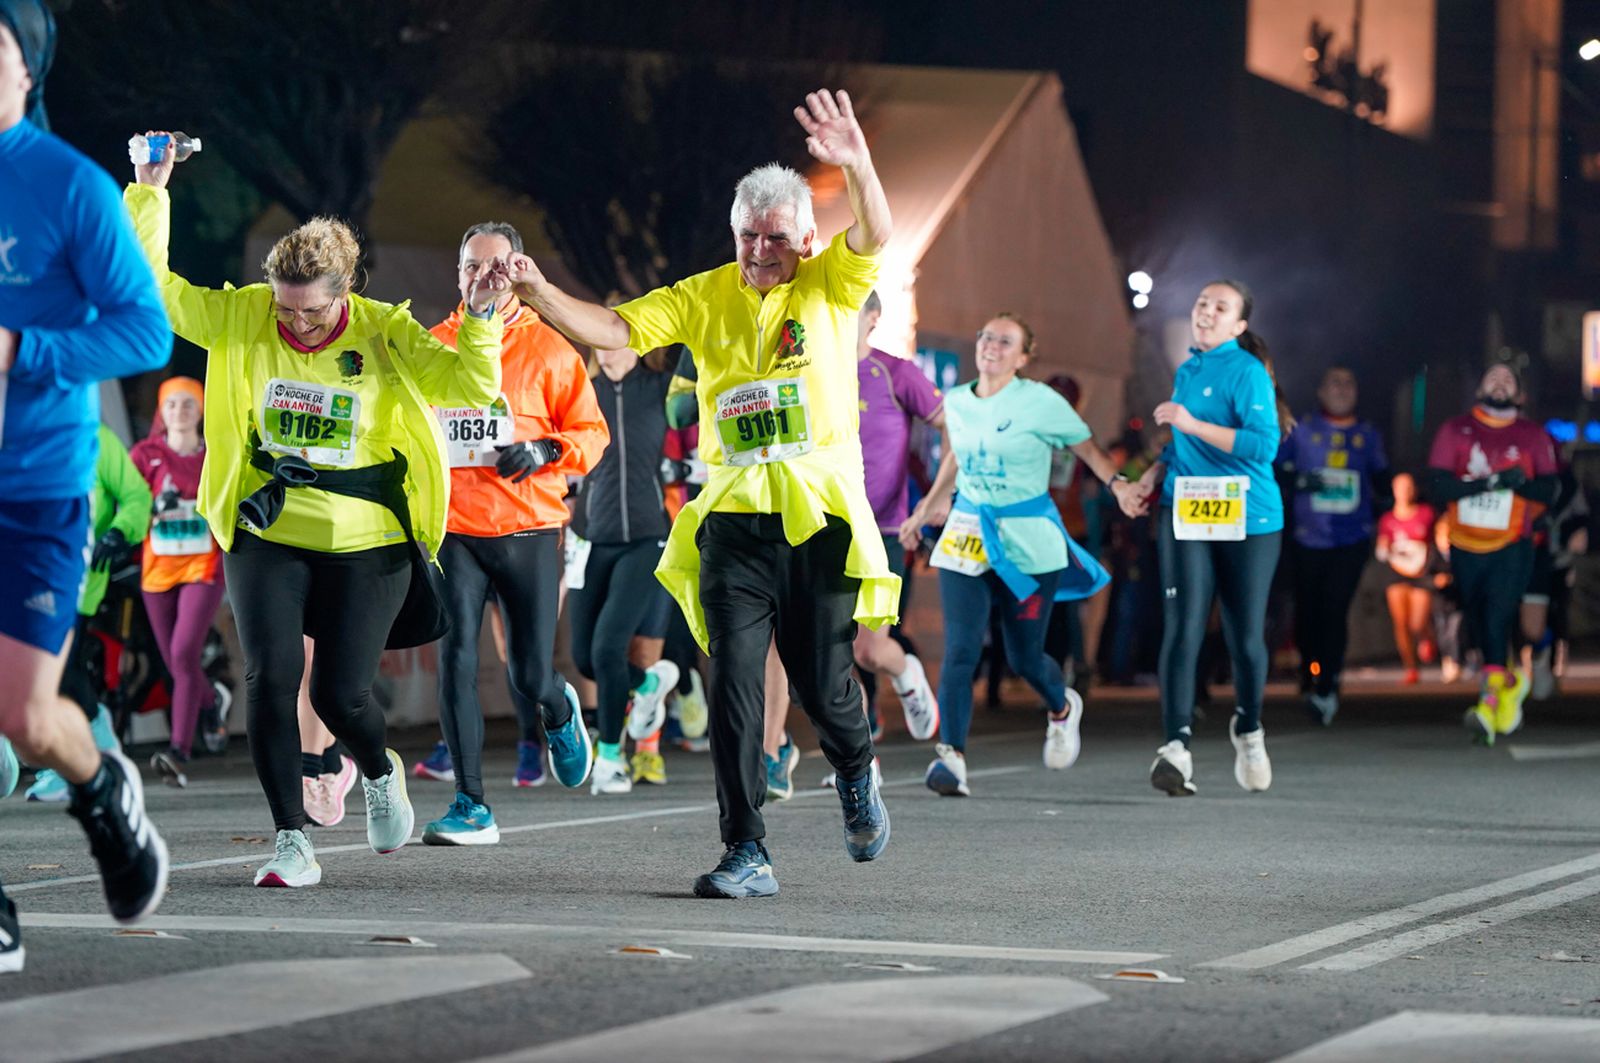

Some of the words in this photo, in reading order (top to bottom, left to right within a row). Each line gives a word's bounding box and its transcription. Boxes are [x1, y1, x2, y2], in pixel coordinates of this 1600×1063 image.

[272, 399, 290, 409] SAN
[284, 390, 312, 402] NOCHE
[313, 394, 325, 404] DE
[730, 392, 758, 404] NOCHE
[758, 390, 769, 399] DE
[722, 407, 741, 419] SAN
[280, 410, 337, 440] 9162
[449, 418, 499, 441] 3634
[736, 409, 789, 442] 9161
[1190, 500, 1231, 518] 2427
